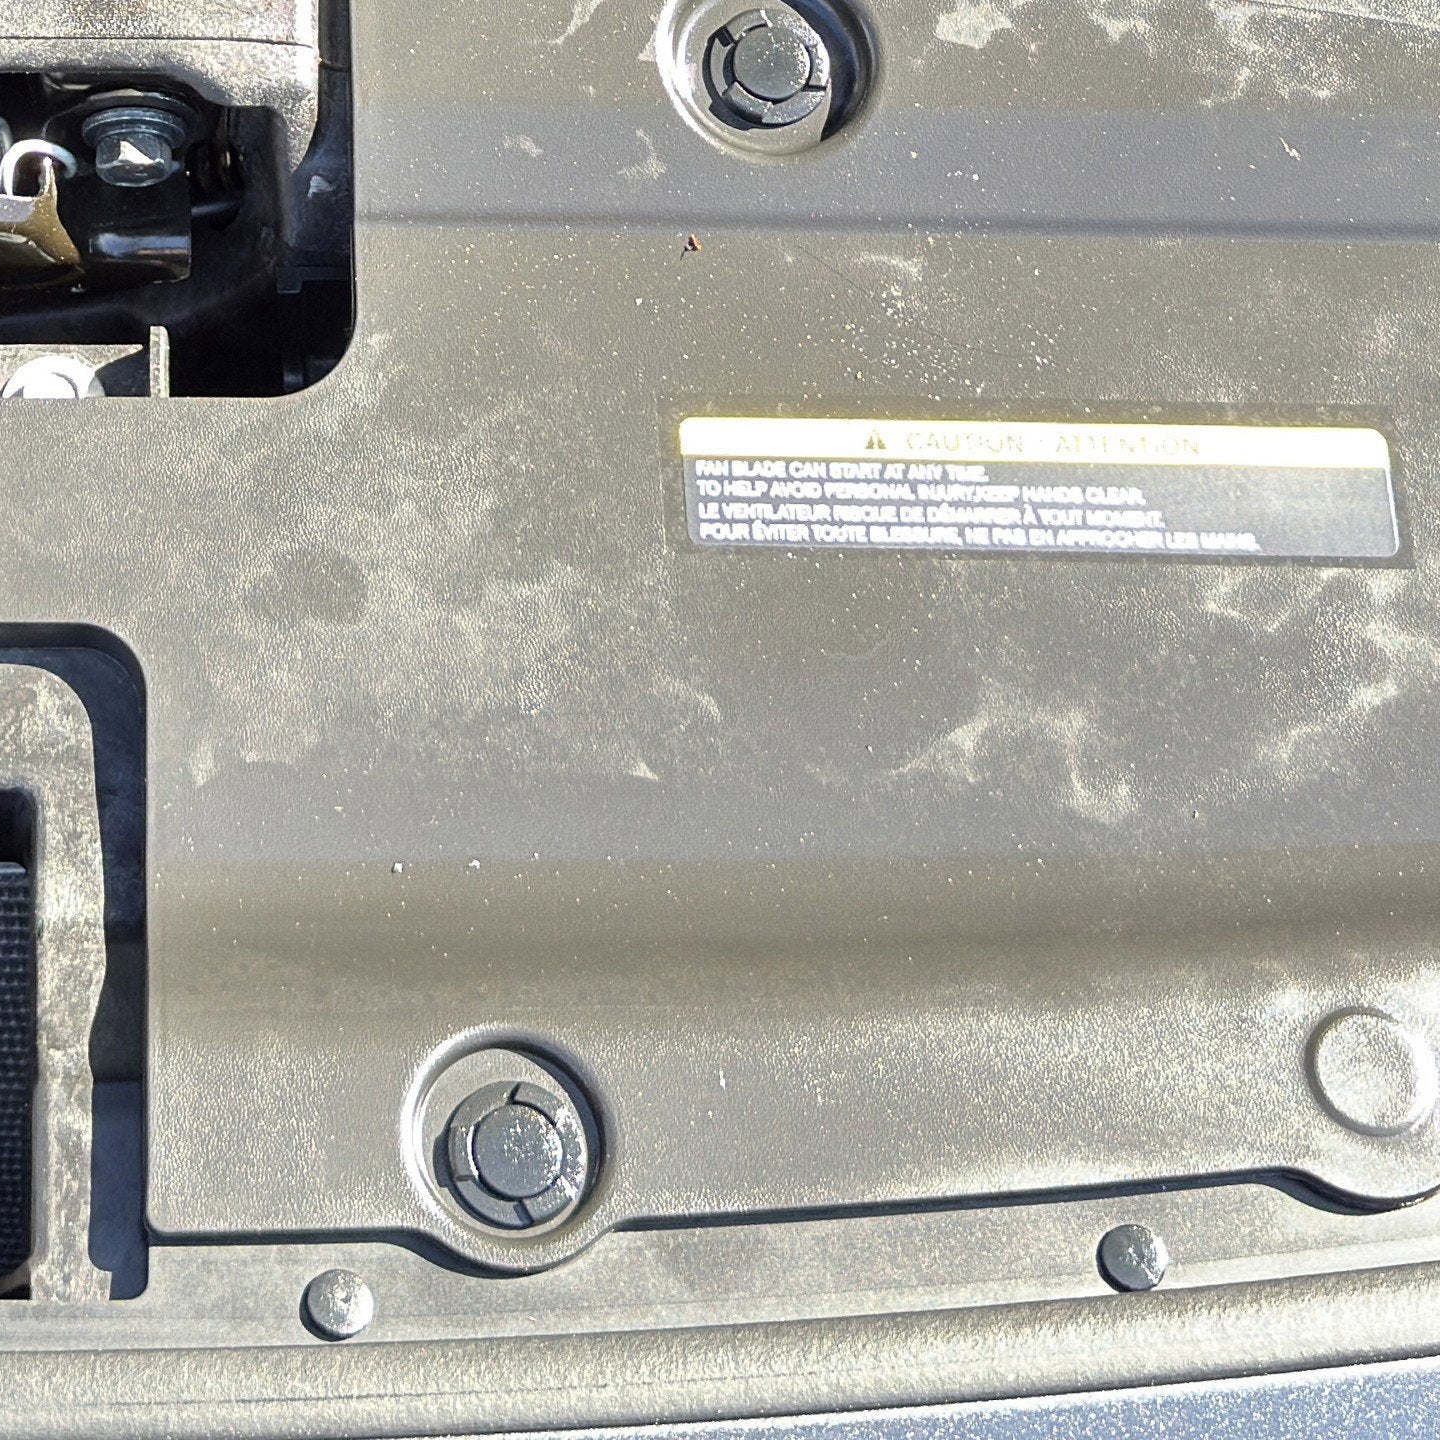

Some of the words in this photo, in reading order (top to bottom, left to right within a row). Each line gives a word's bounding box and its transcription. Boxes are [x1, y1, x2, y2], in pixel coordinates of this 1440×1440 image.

[695, 459, 729, 477] FAN
[731, 460, 787, 478] BLADE
[789, 460, 827, 479] CAN
[829, 462, 882, 480] START
[883, 463, 906, 480] AT
[696, 480, 720, 497] TO
[723, 480, 769, 498] HELP
[770, 481, 823, 499] AVOID
[1022, 485, 1084, 504] HANDS
[698, 502, 720, 519] LE
[722, 502, 831, 522] VENTILATEUR
[900, 505, 925, 523] DE
[699, 522, 750, 540] POUR
